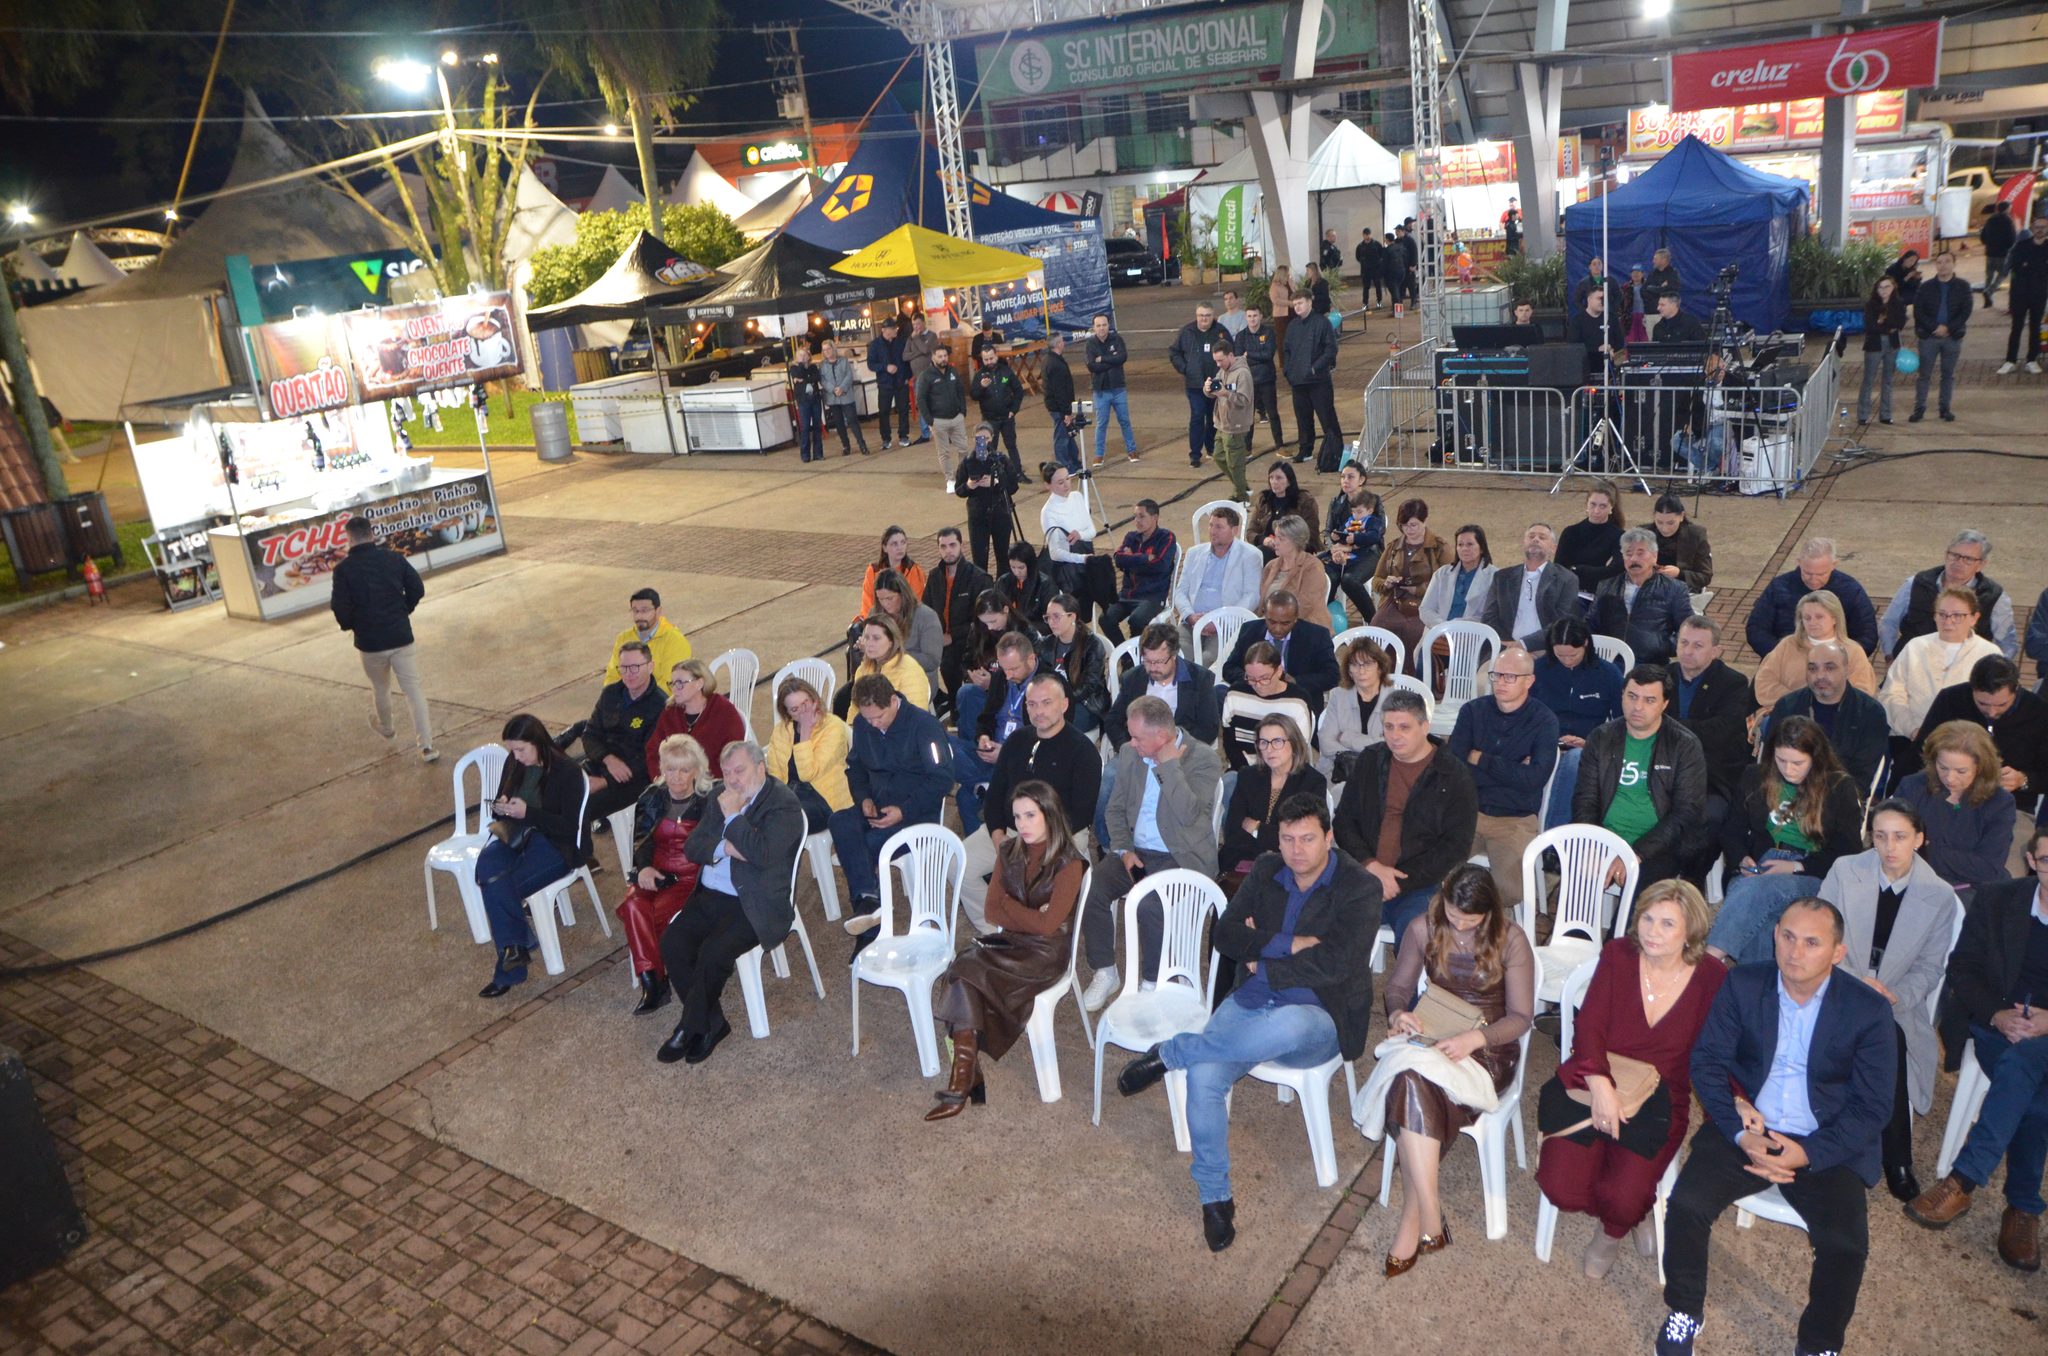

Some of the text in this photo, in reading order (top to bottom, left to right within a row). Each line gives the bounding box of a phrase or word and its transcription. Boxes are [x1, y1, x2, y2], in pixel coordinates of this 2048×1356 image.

[1063, 15, 1267, 69] SC INTERNACIONAL
[1070, 64, 1133, 84] CONSULADO
[1137, 58, 1179, 75] OFICIAL
[1185, 55, 1201, 70] DE
[1015, 226, 1043, 238] VEICULAR
[1043, 225, 1061, 234] TOTAL
[1081, 220, 1096, 230] STAR
[1225, 200, 1236, 243] Sicredi
[1074, 240, 1088, 249] STAR
[835, 290, 864, 301] HOFFNUNG
[985, 302, 991, 312] A
[992, 295, 1026, 311] PROTEÇÃO
[1059, 286, 1071, 299] QUE
[697, 306, 724, 316] HOFFNUNG
[997, 313, 1012, 326] AMA
[407, 336, 471, 367] CHOCOLATE
[423, 357, 466, 380] QUENTE
[270, 356, 348, 418] QUENTÃO
[371, 512, 435, 537] Chocolate
[259, 512, 354, 566] TCHÊ
